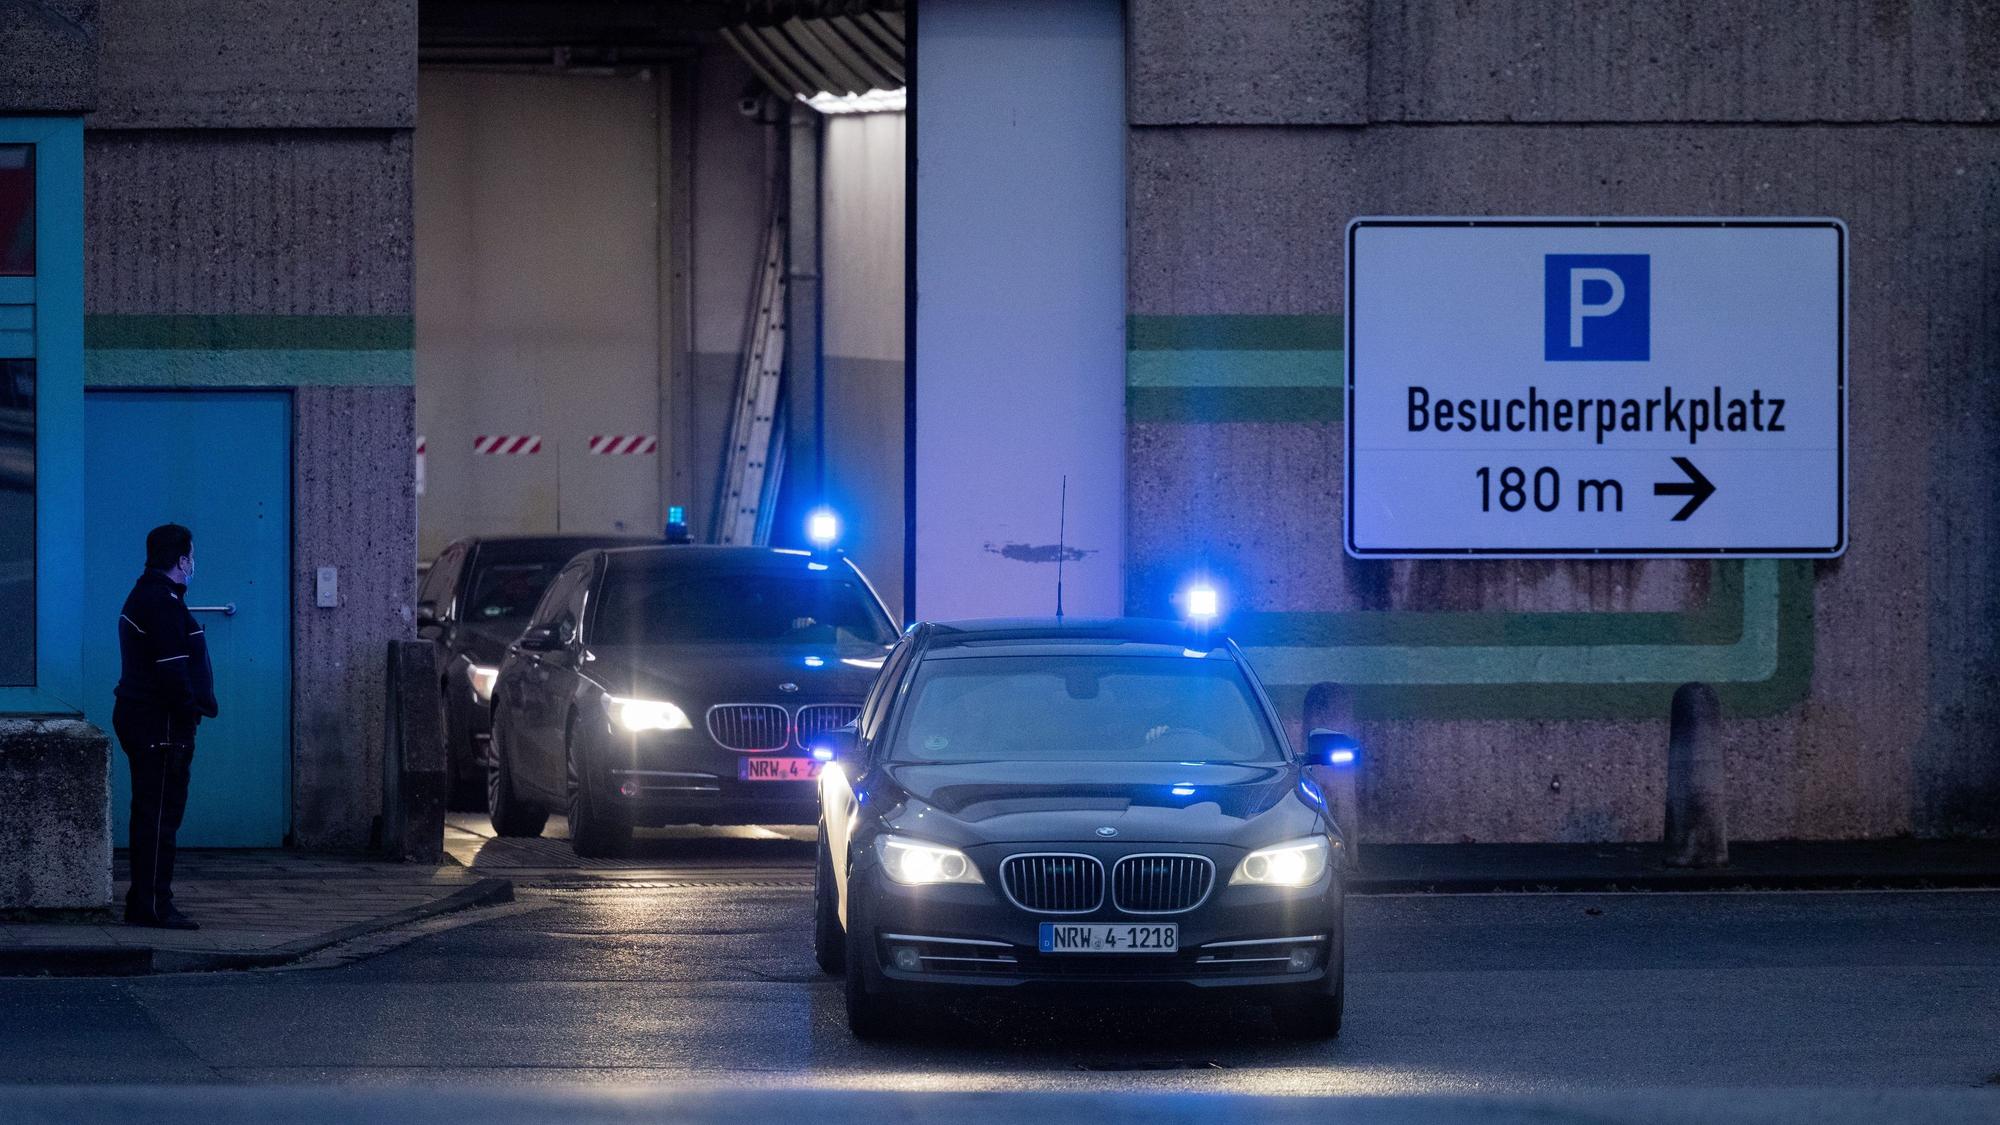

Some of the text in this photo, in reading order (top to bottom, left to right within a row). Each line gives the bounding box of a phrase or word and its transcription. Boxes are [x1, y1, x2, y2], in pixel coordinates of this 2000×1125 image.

[1570, 267, 1625, 347] P
[1407, 386, 1786, 444] Besucherparkplatz
[1475, 466, 1624, 512] 180 m
[749, 761, 779, 777] NRW
[789, 761, 820, 777] 4-2
[1054, 927, 1175, 948] NRW 4-1218
